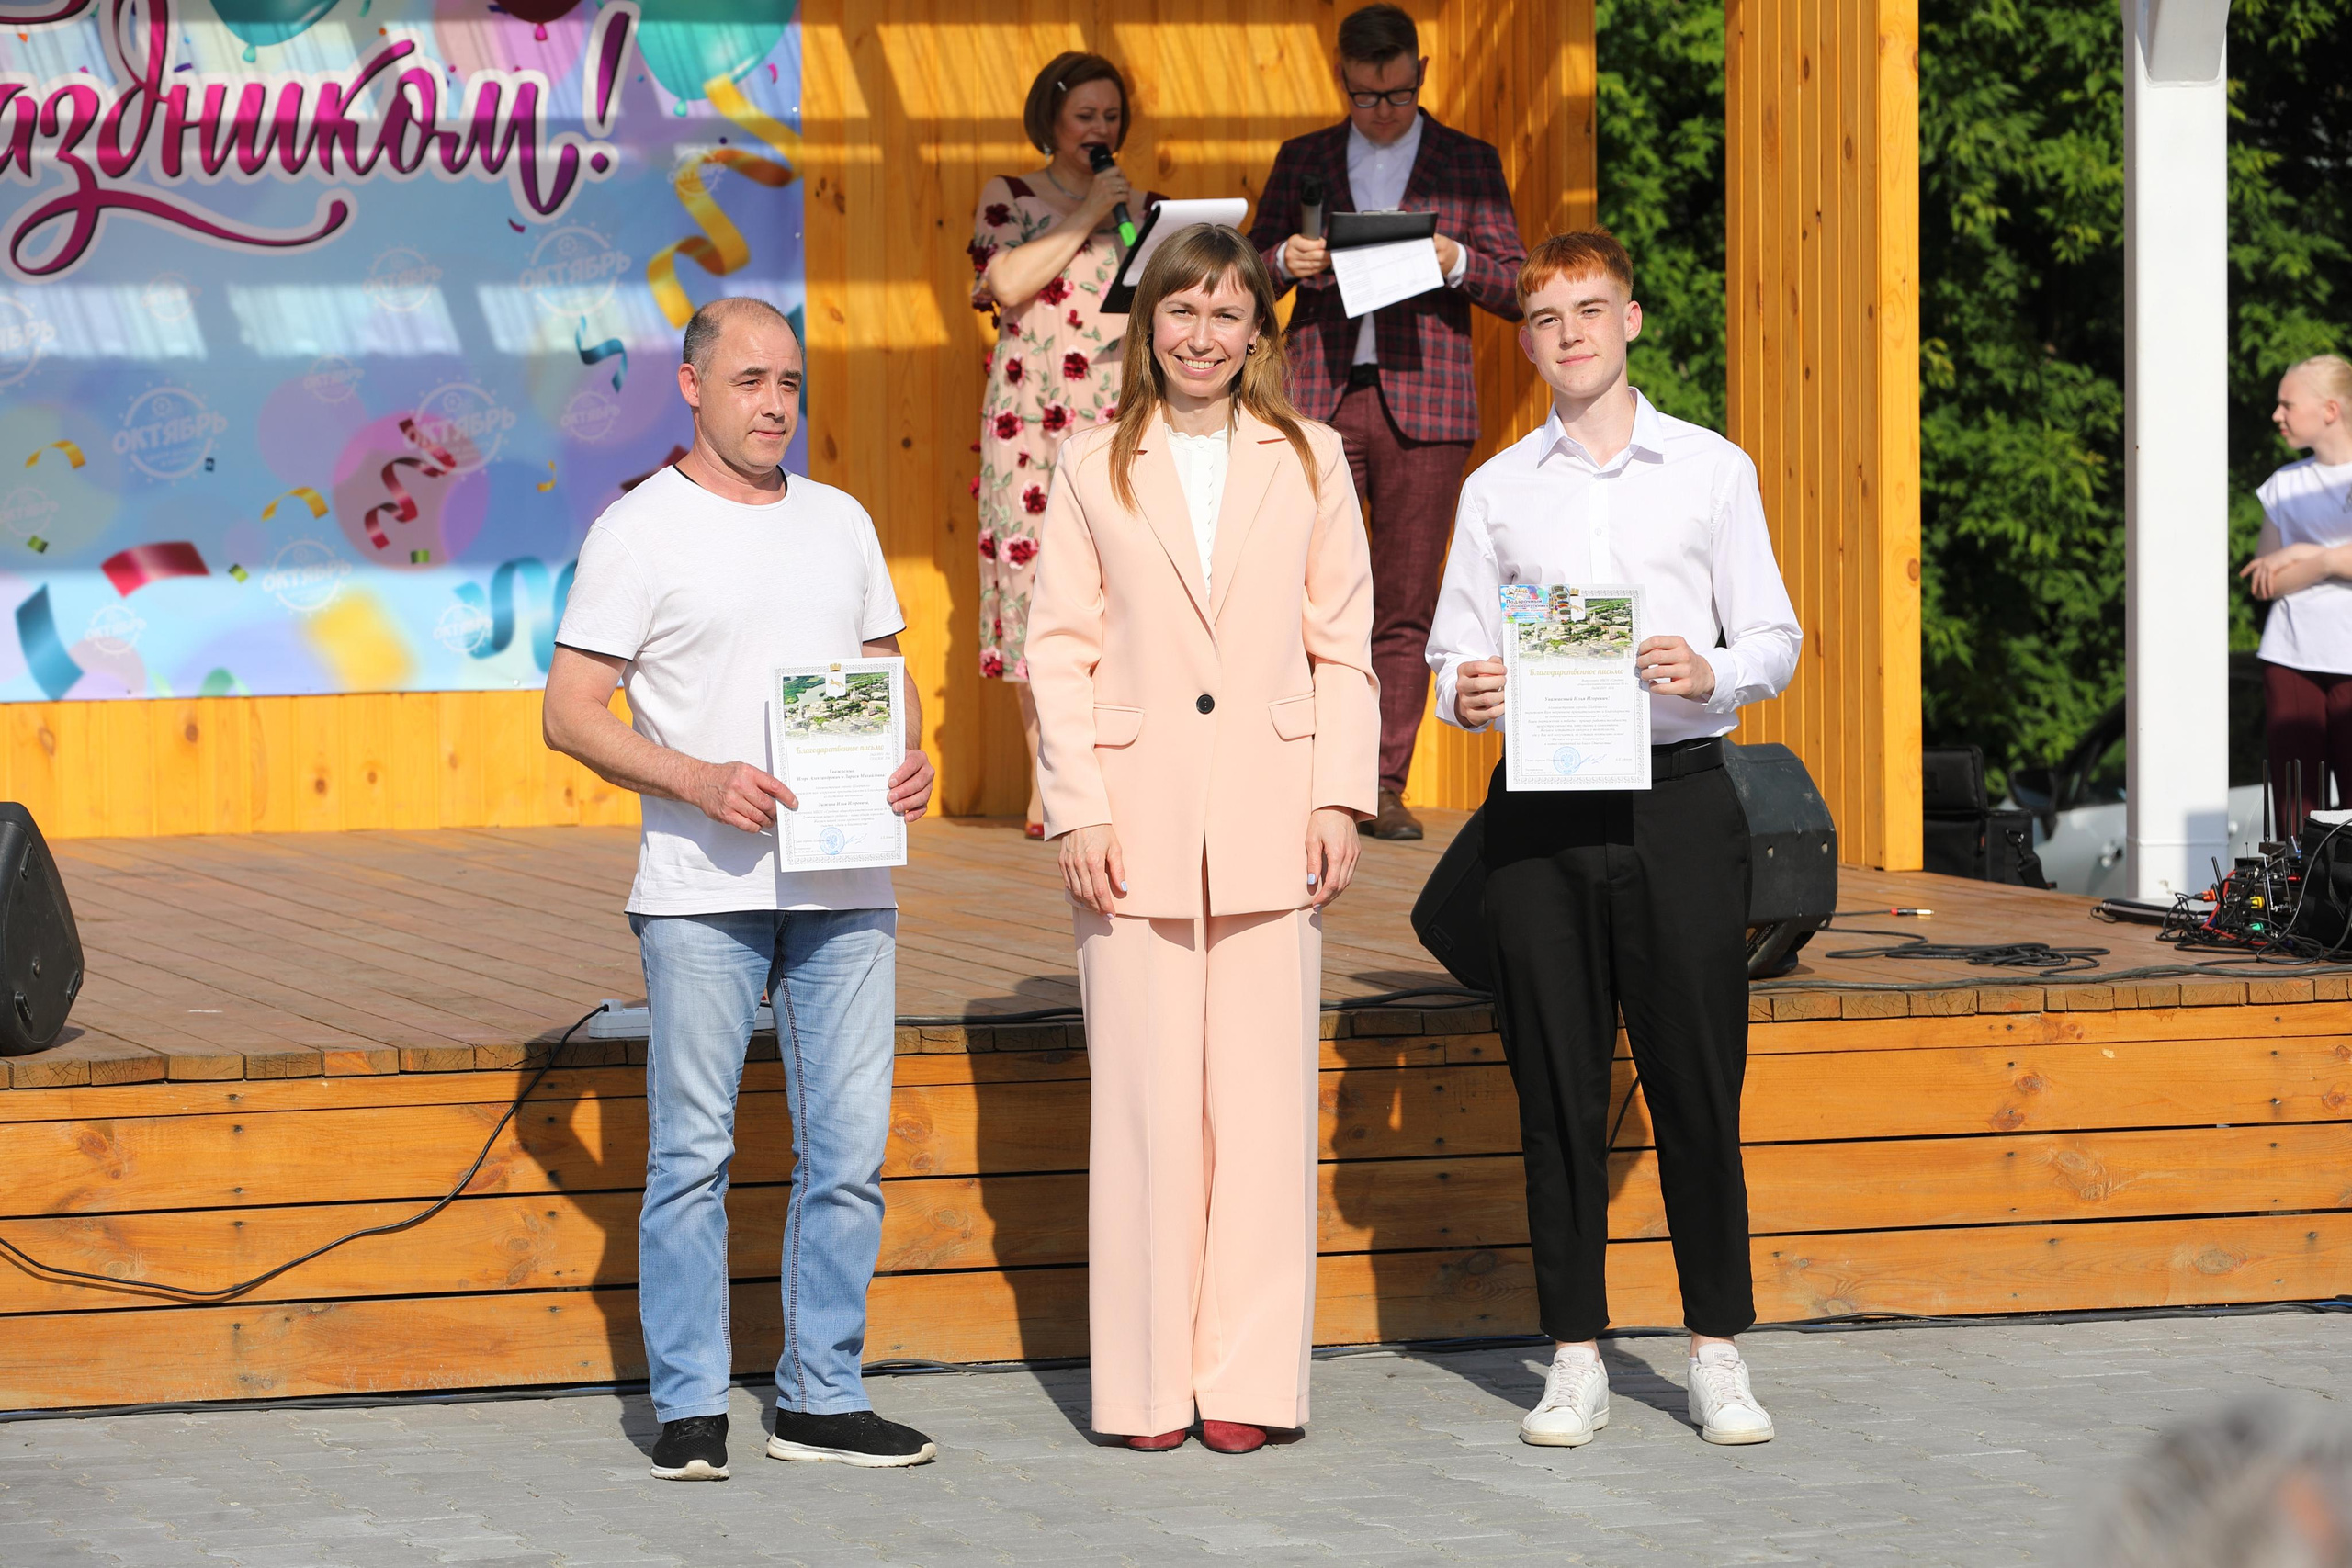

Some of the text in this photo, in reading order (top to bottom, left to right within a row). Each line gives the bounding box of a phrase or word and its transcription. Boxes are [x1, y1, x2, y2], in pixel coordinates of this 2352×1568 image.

[519, 251, 632, 293] ОКТЯБРЬ
[112, 410, 228, 455] ОКТЯБРЬ
[401, 405, 517, 451] ОКТЯБРЬ
[1529, 668, 1596, 677] Благодарственное
[796, 746, 858, 755] Благодарственное
